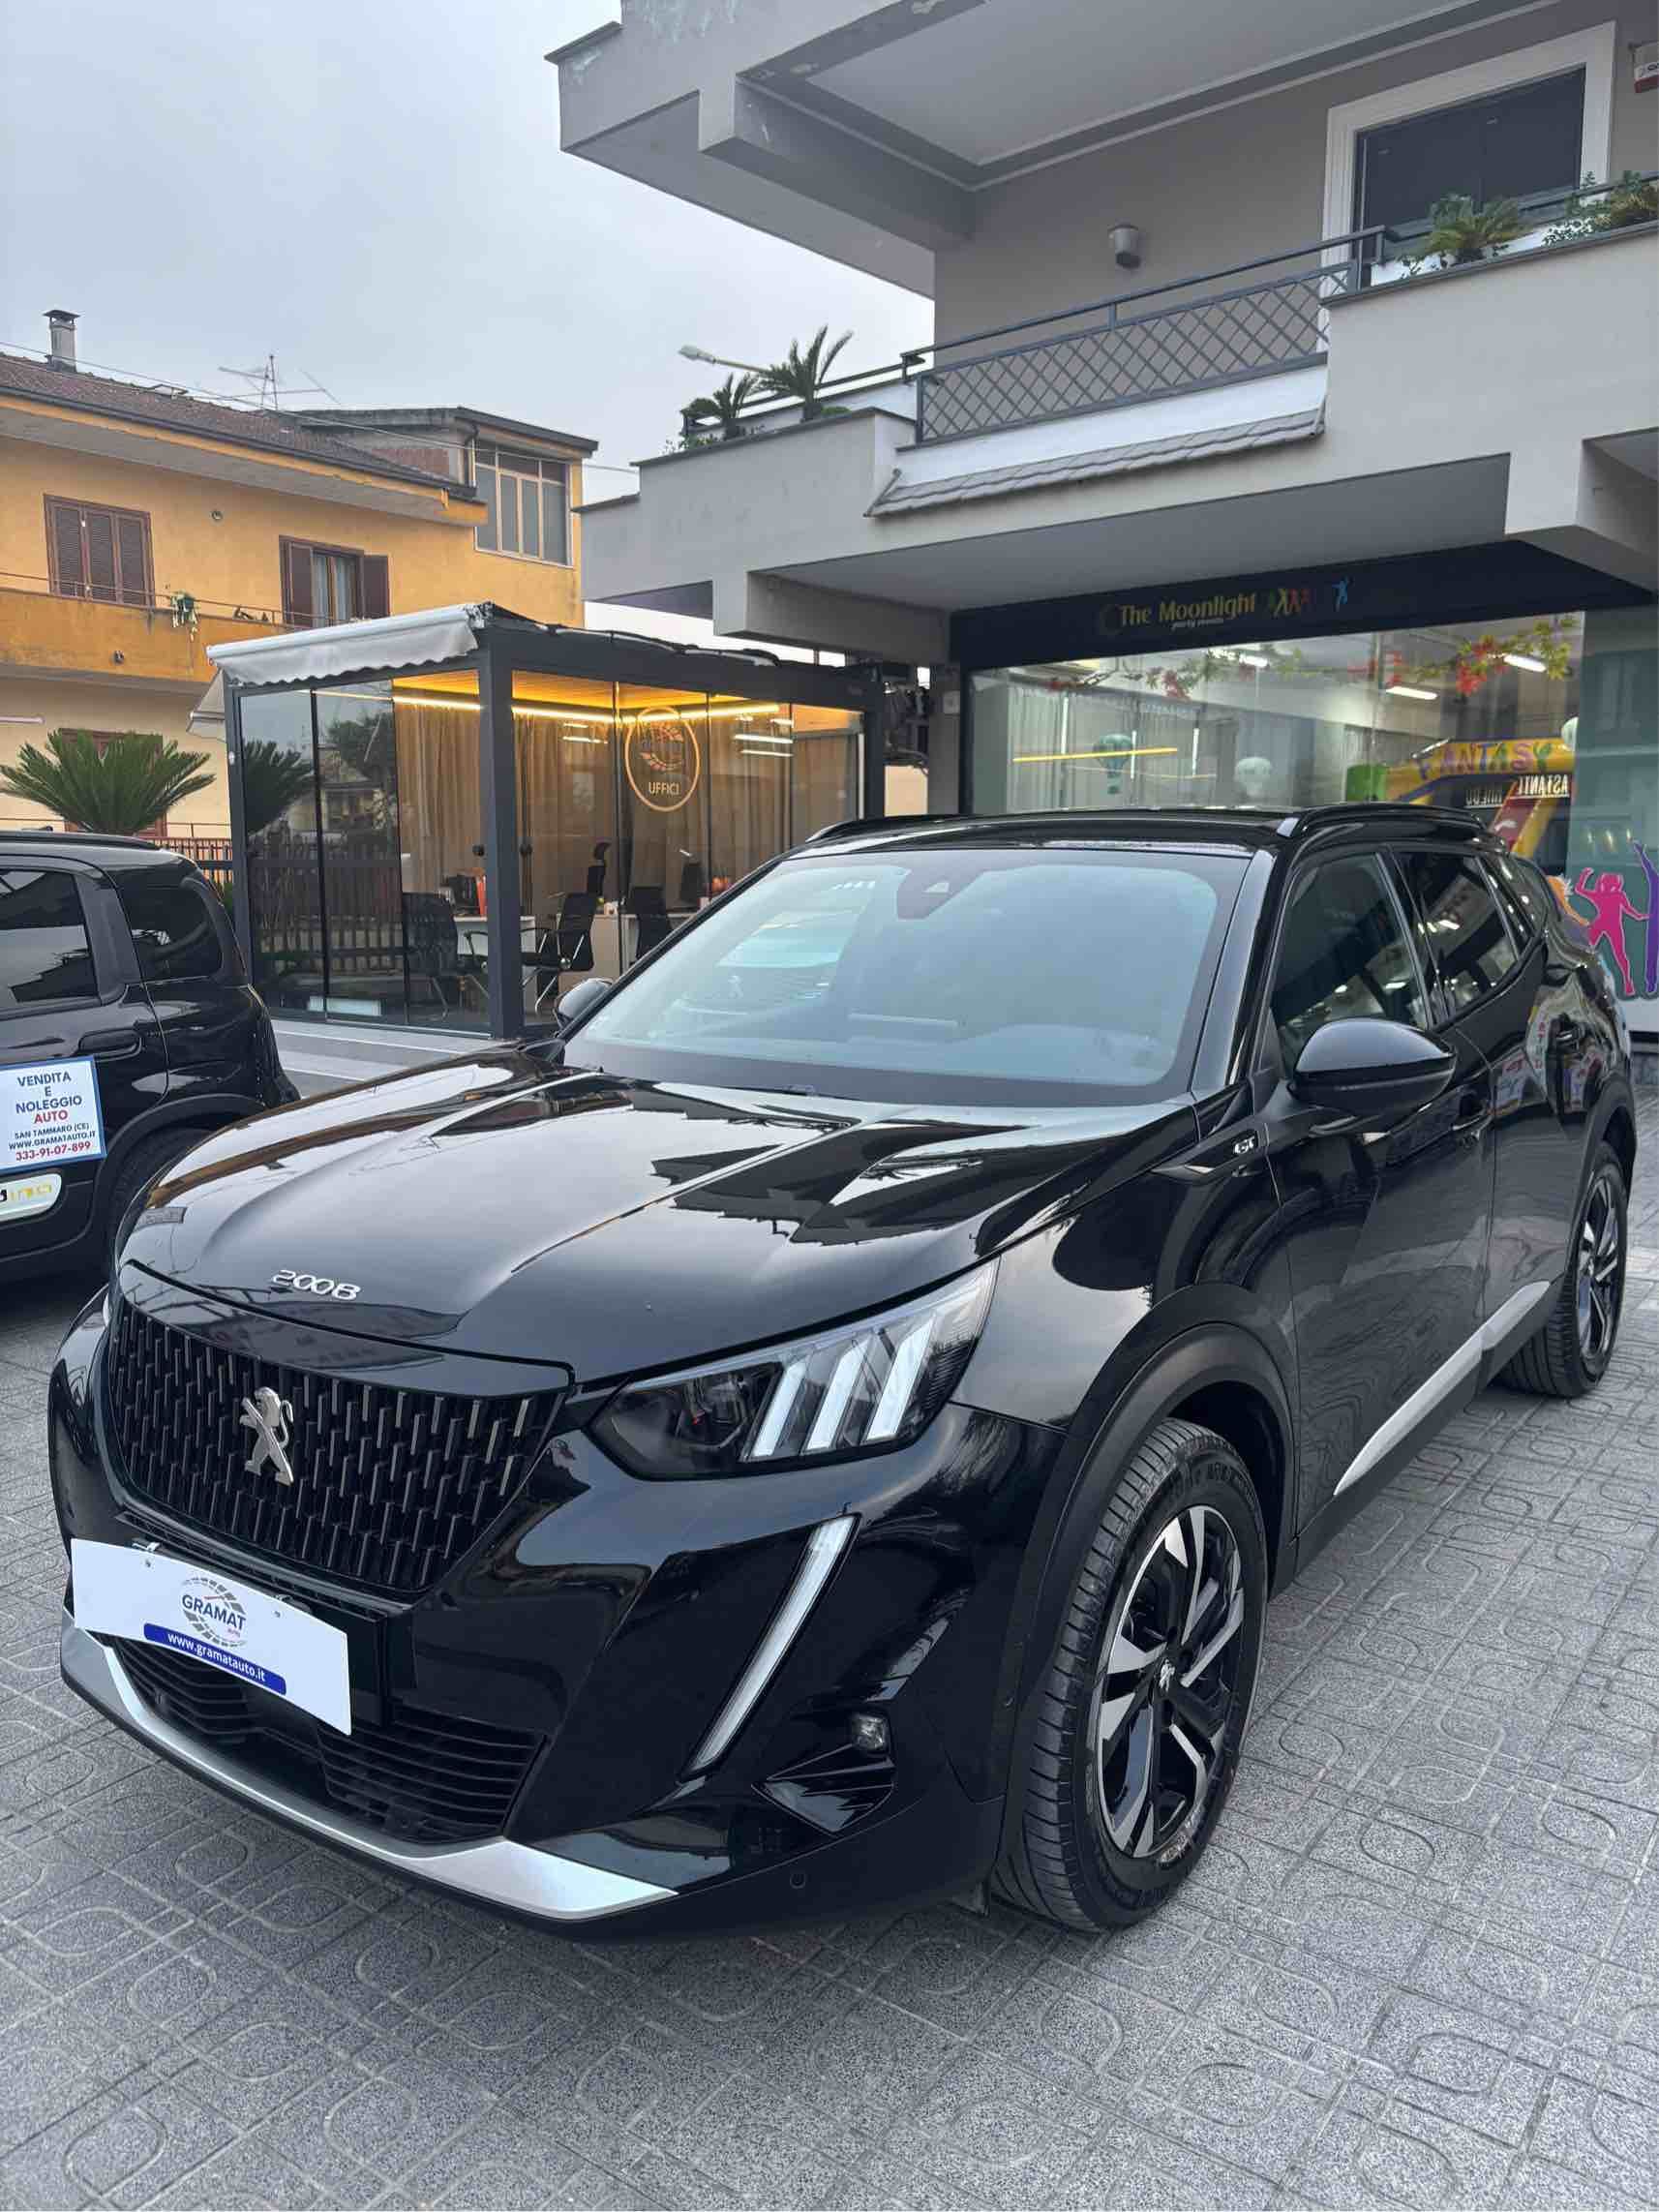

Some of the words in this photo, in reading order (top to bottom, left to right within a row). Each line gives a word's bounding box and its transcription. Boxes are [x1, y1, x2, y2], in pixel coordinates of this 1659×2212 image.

[1120, 604, 1152, 627] The
[1160, 592, 1255, 621] Moonlight
[1416, 741, 1553, 780] FANTASY
[648, 781, 680, 795] UFFICI
[17, 1071, 72, 1086] VENDITA
[45, 1086, 51, 1096] E
[15, 1095, 82, 1113] NOLEGGIO
[34, 1109, 68, 1123] AUTO
[15, 1131, 31, 1139] SAN
[33, 1124, 72, 1136] TAMMARO
[74, 1122, 89, 1131] (CE)
[9, 1131, 95, 1149] WWW.GRAMATAUTO.IT
[15, 1140, 91, 1161] 333-91-07-899
[272, 1269, 361, 1300] 2008
[182, 1594, 246, 1630] GRAMAT
[166, 1631, 266, 1682] www.gramatauto.it
